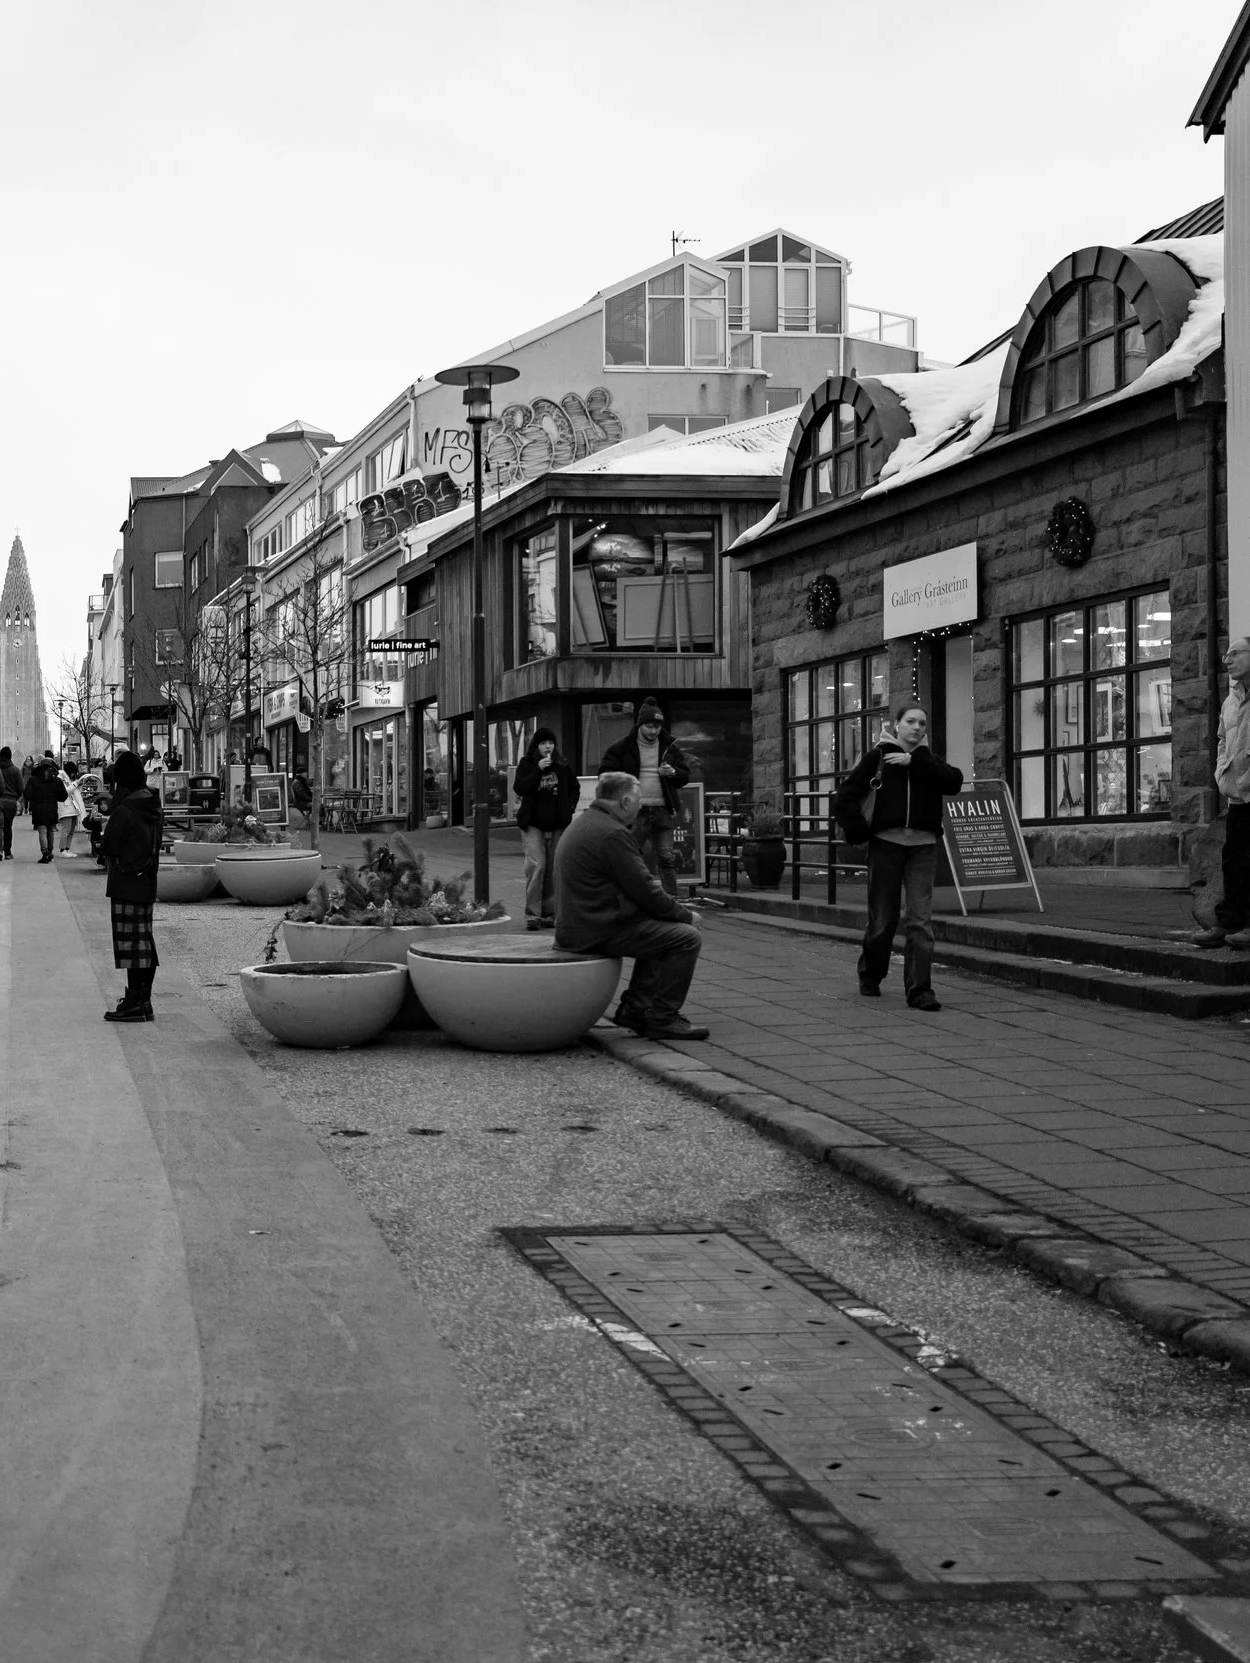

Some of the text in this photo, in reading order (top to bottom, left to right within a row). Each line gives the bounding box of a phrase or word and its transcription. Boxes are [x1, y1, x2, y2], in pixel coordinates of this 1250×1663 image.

[891, 576, 968, 608] Gallery Grásteinn
[371, 641, 390, 650] lurie
[396, 641, 413, 649] fine
[947, 800, 1000, 817] HYALIN
